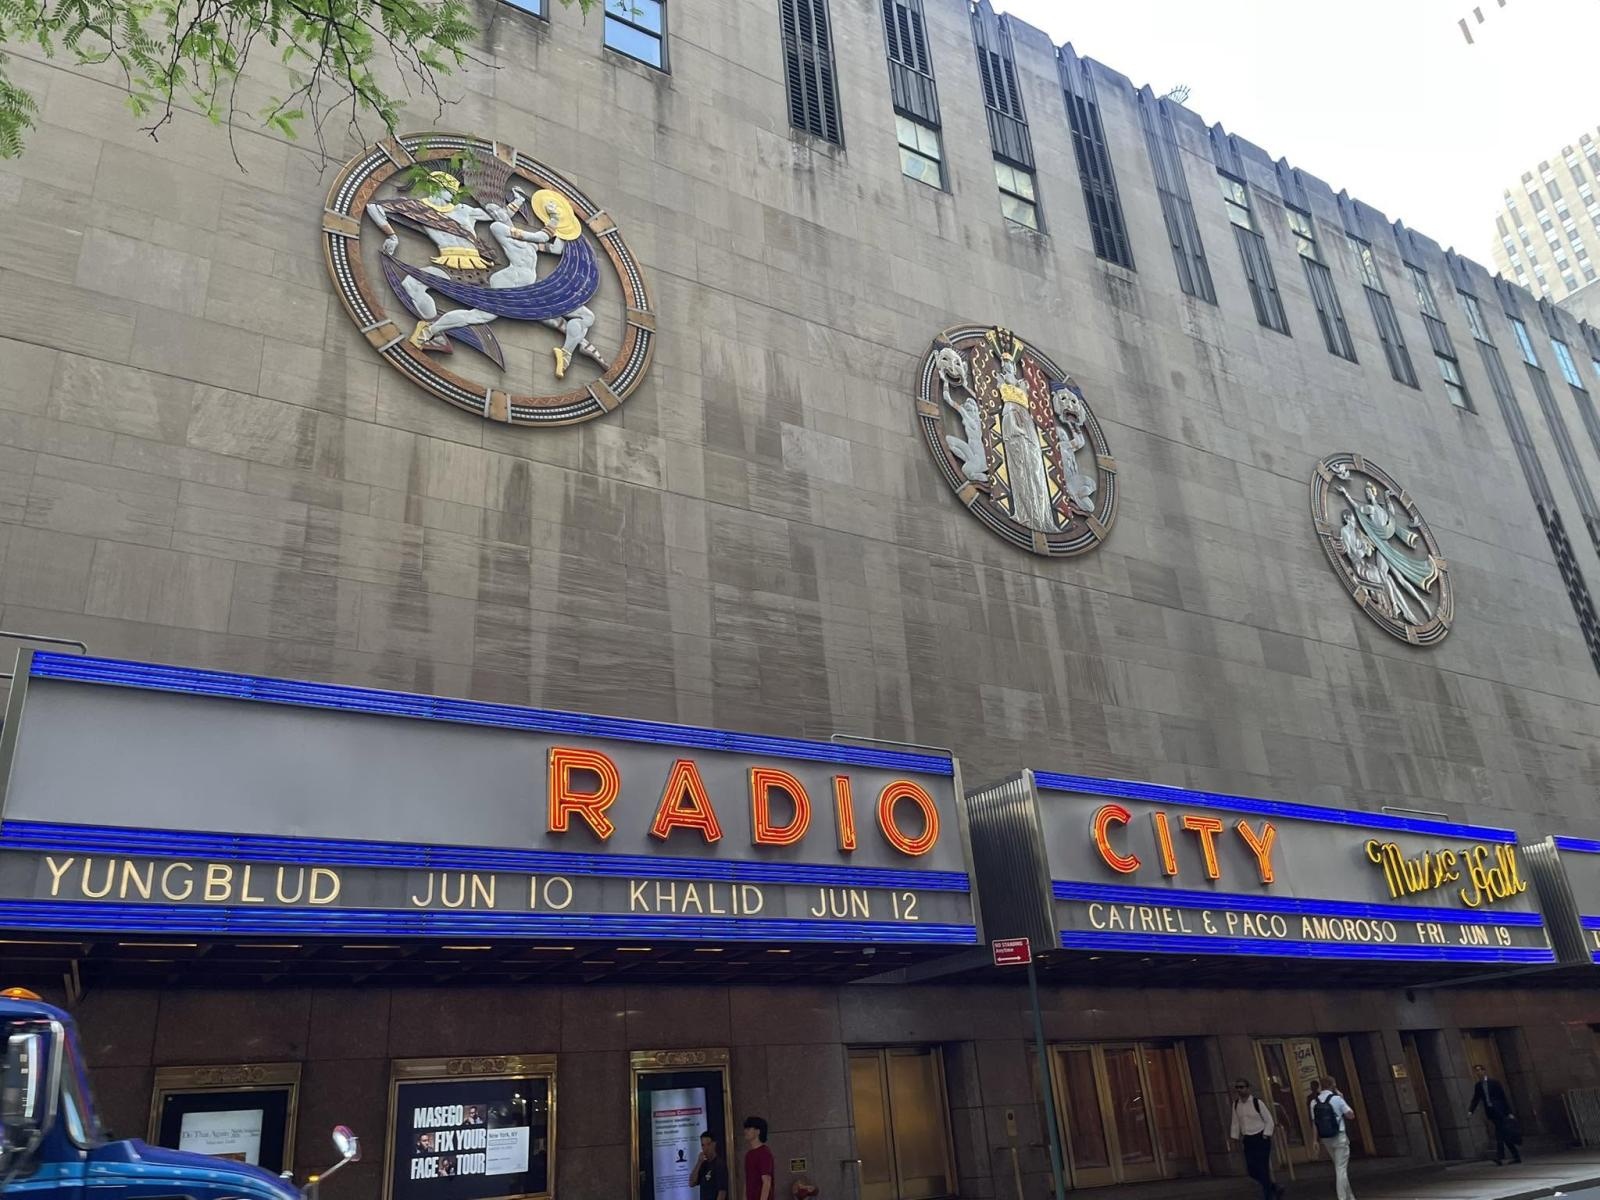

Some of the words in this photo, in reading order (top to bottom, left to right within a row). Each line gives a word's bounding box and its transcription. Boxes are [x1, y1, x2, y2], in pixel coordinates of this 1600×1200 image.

[546, 745, 940, 857] RADIO
[1089, 803, 1277, 885] CITY
[1366, 839, 1459, 898] Music
[1459, 843, 1527, 907] Hall
[45, 856, 341, 904] YUNGBLUD
[411, 873, 496, 909] JUN
[530, 876, 573, 910] 10
[629, 880, 764, 915] KHALID
[811, 888, 870, 919] JUN
[892, 892, 919, 920] 12
[1088, 903, 1193, 933] CA7RIEL
[1202, 910, 1218, 935] &
[1225, 912, 1288, 938] PACO
[1302, 916, 1397, 942] AMOROSO
[1416, 923, 1451, 944] FRI.
[1459, 925, 1489, 946] JUN
[1494, 927, 1512, 946] 19
[413, 1105, 464, 1129] MASEGO
[434, 1131, 455, 1153] FIX
[456, 1128, 487, 1151] YOUR
[410, 1157, 440, 1180] FACE
[456, 1153, 486, 1175] TOUR
